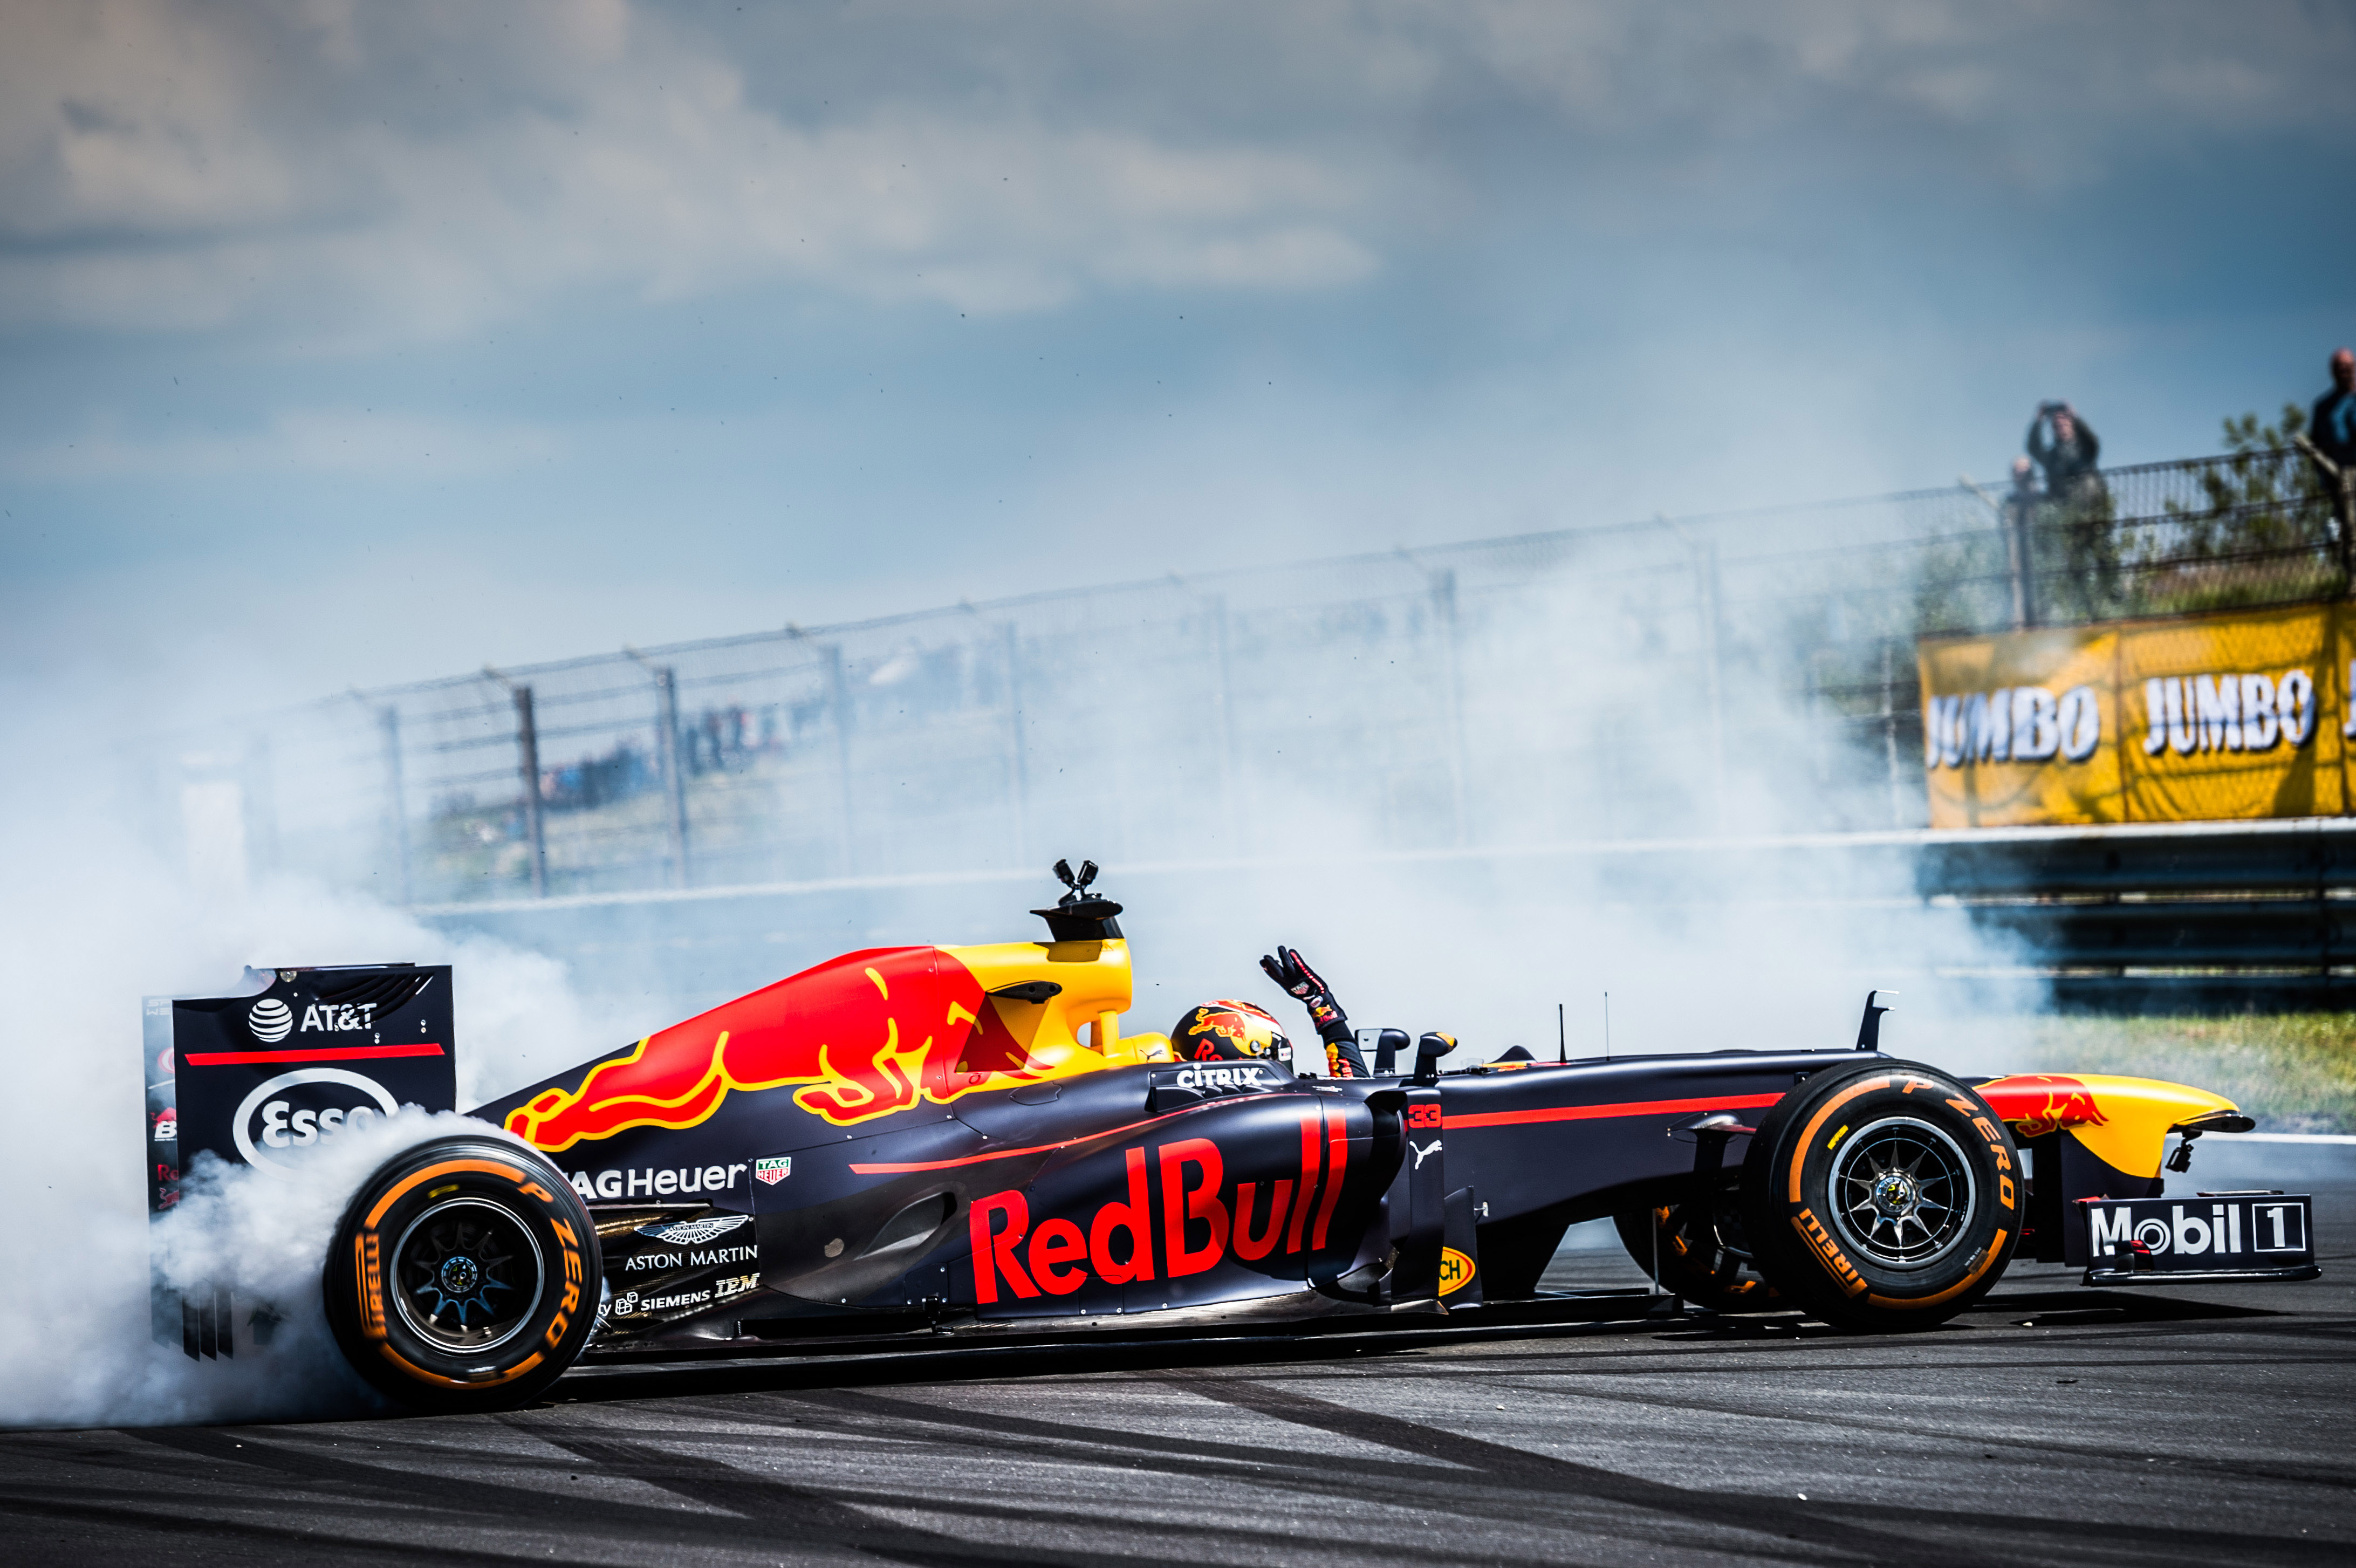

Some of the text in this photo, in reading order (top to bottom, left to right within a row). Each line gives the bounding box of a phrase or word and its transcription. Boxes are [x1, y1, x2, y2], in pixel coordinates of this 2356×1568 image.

[2143, 669, 2316, 755] JUMBO
[1927, 685, 2100, 769] JUMBO
[300, 1003, 377, 1032] AT&T
[1408, 1105, 1442, 1128] 33
[759, 1159, 787, 1169] TAG
[1946, 1093, 2016, 1210] ZERO
[757, 1169, 788, 1182] HEUER
[2090, 1203, 2285, 1257] Mobil 1
[625, 1245, 758, 1271] ASTON MARTIN
[1790, 1208, 1868, 1298] PIRELLI
[545, 1217, 583, 1351] ZERO
[714, 1272, 761, 1298] IBM
[641, 1290, 711, 1311] SIEMENS
